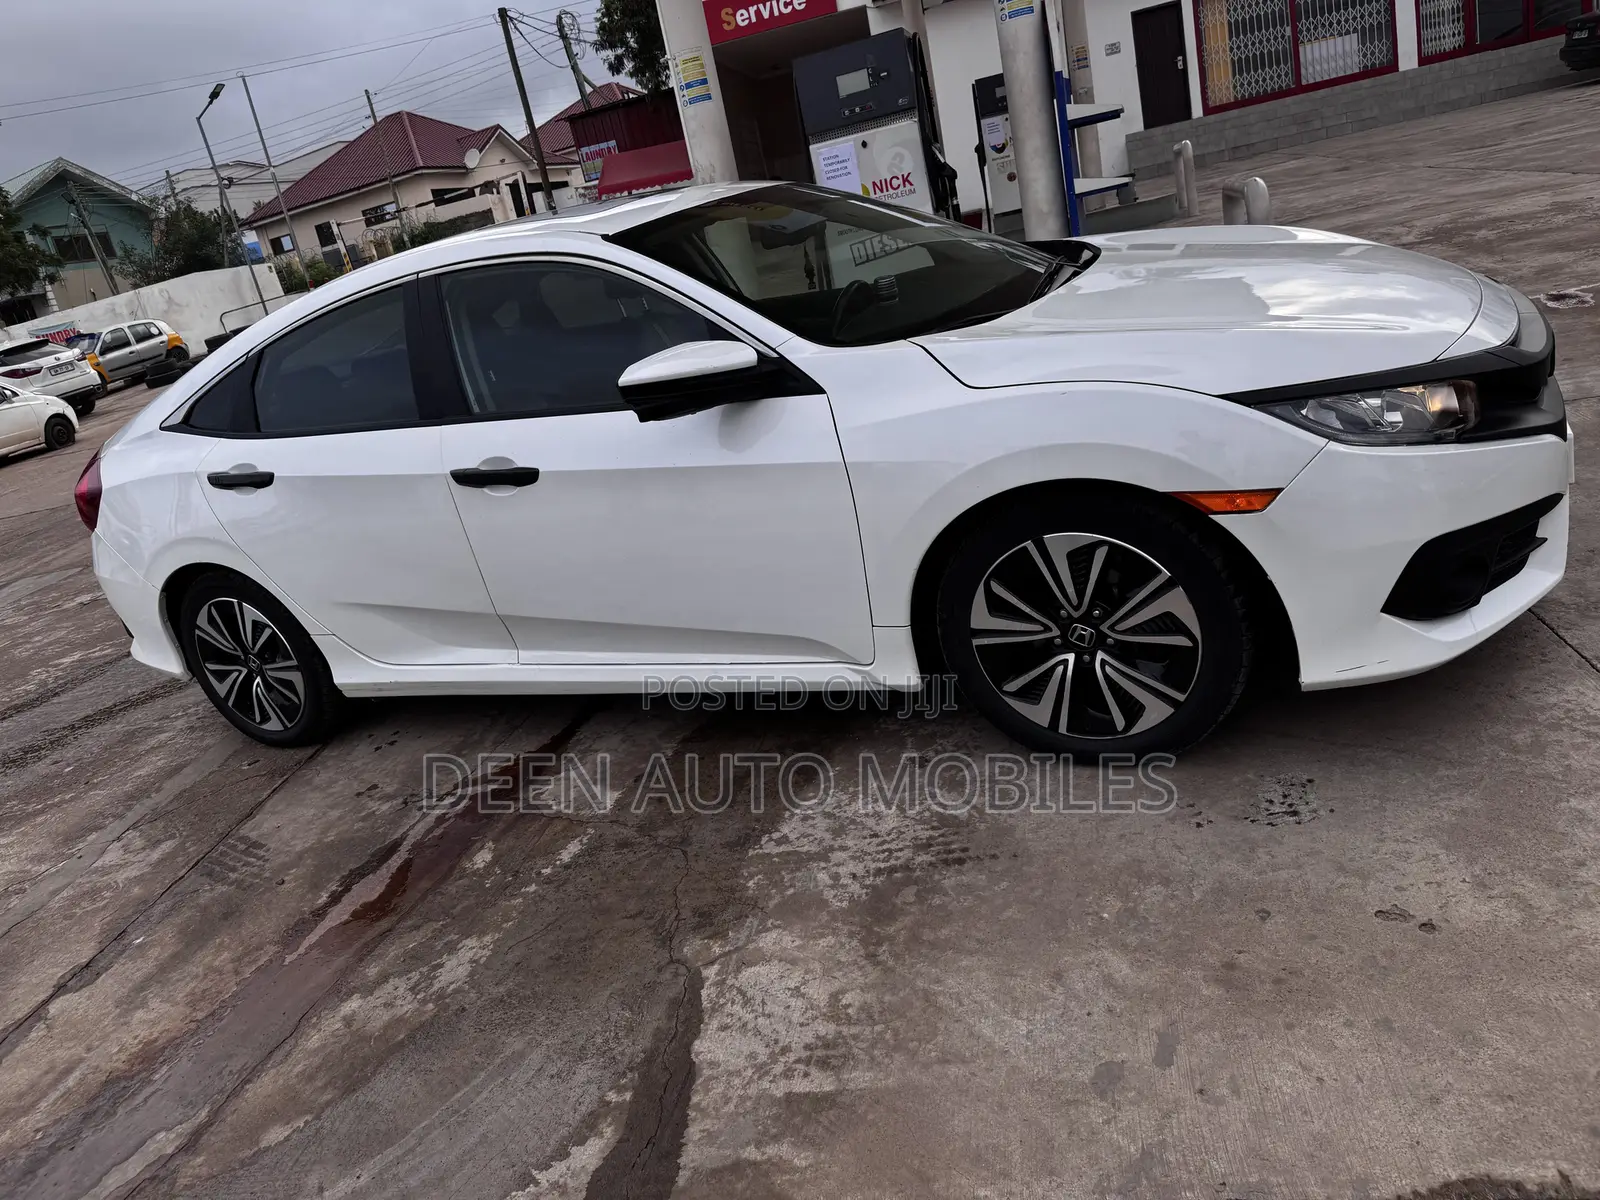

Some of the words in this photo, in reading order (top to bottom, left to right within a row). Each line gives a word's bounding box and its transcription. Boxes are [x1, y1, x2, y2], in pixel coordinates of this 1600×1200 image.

[721, 0, 807, 31] Service
[824, 158, 850, 168] TEMPORARILY
[872, 172, 914, 195] NICK
[874, 188, 916, 201] ETROLEUM
